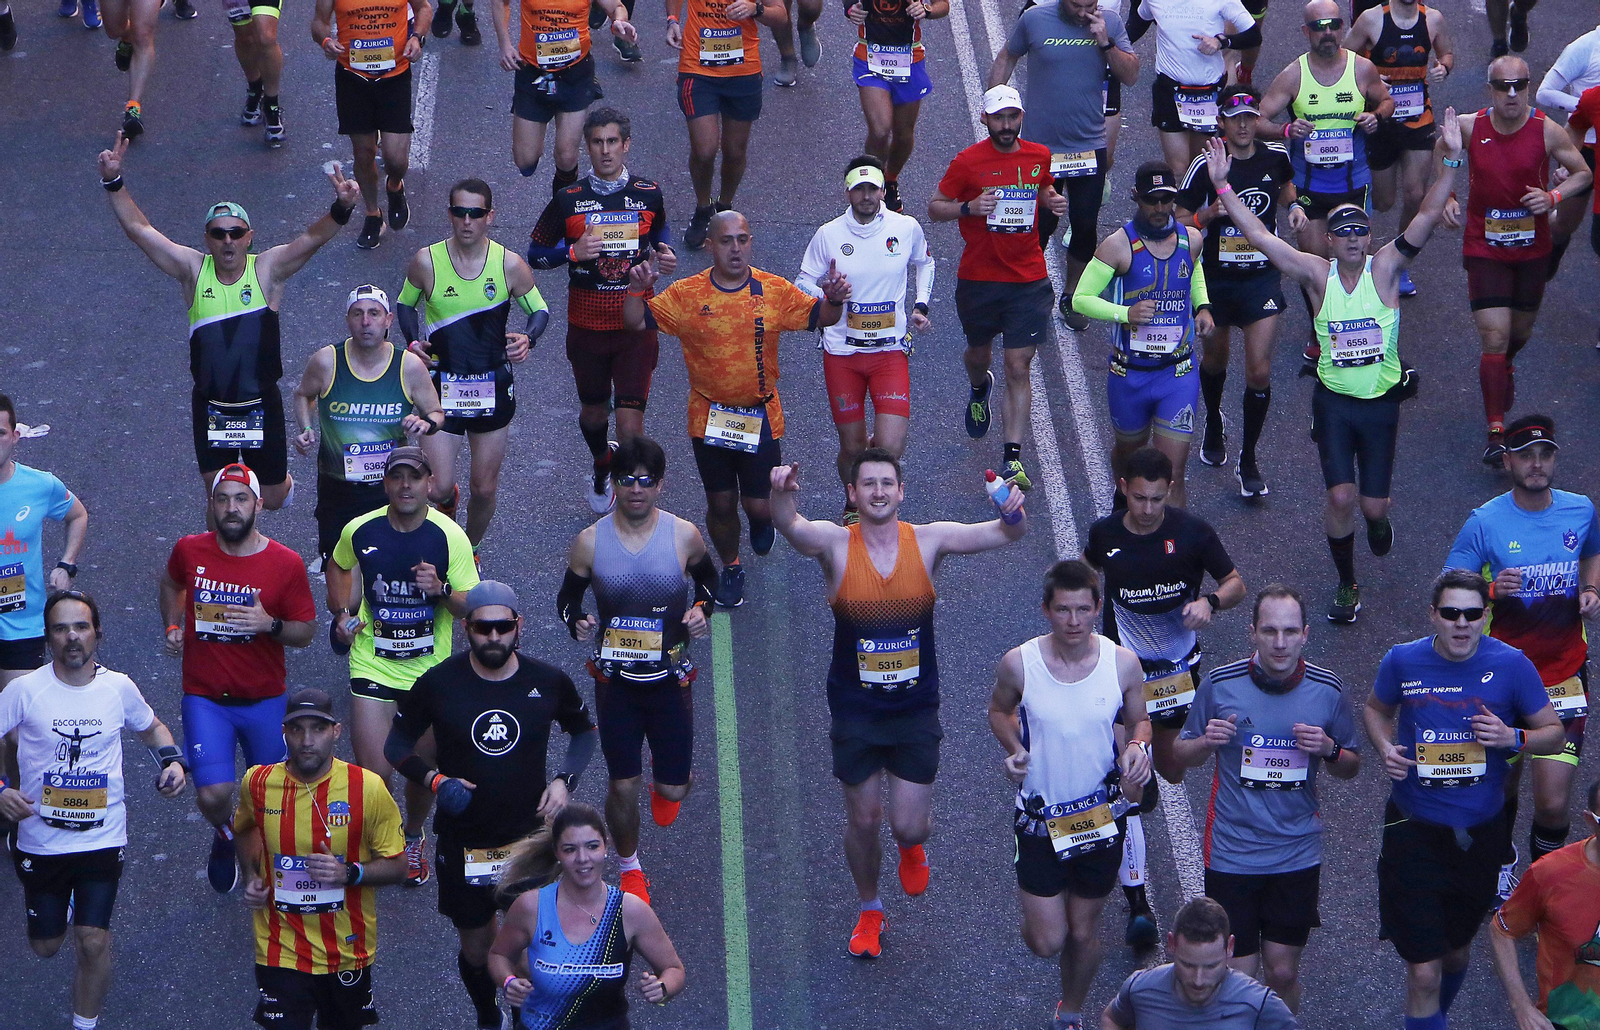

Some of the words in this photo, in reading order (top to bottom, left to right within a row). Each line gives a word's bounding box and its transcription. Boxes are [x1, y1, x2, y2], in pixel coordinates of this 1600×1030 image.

[705, 1, 728, 9] PONT
[539, 16, 569, 24] PONTO
[697, 11, 728, 20] ENCON
[349, 22, 397, 31] ENCONTRO
[548, 31, 575, 42] ZURICH
[712, 29, 738, 38] ZURICH
[362, 39, 389, 48] ZURICH
[713, 43, 732, 52] 5215
[550, 46, 569, 55] 4903
[881, 45, 907, 53] ZURICH
[363, 54, 382, 62] 5058
[548, 54, 572, 63] PACHECO
[880, 59, 898, 67] 6703
[1394, 85, 1419, 94] ZURICH
[1187, 94, 1213, 103] ZURICH
[1188, 108, 1206, 116] 7193
[1394, 109, 1410, 117] AITOR
[1319, 131, 1347, 139] ZURICH
[1319, 145, 1339, 154] 6800
[1063, 152, 1082, 161] 4214
[1319, 155, 1339, 163] MICUPI
[1059, 161, 1087, 171] FRAGUELA
[1006, 190, 1033, 199] ZURICH
[1004, 207, 1024, 215] 9328
[603, 214, 633, 223] ZURICH
[1000, 217, 1025, 226] ALBERTO
[603, 231, 624, 240] 5682
[1234, 254, 1255, 262] VICENT
[862, 304, 891, 313] ZURICH
[861, 320, 882, 330] 5699
[1344, 319, 1376, 331] ZURICH
[1146, 334, 1168, 343] 8124
[1346, 337, 1369, 348] 6558
[1146, 344, 1166, 352] DOMIN
[1355, 349, 1360, 358] Y
[1360, 346, 1381, 357] PEDRO
[754, 316, 766, 393] MARCHENA
[458, 372, 489, 383] ZURICH
[458, 389, 480, 399] 7413
[456, 400, 481, 409] TENORIO
[329, 415, 368, 424] CORREDORES
[225, 421, 247, 430] 2558
[725, 419, 747, 431] 5829
[225, 432, 246, 441] PARRA
[721, 429, 745, 442] BALBOA
[363, 443, 392, 453] ZURICH
[363, 462, 386, 471] 6362
[1119, 583, 1155, 600] Dream
[1154, 580, 1187, 596] Driver
[214, 594, 248, 605] ZURICH
[1127, 596, 1153, 604] COACHING
[1157, 591, 1181, 602] NUTRITION
[652, 606, 668, 614] soar
[213, 612, 226, 622] 41
[391, 610, 427, 620] ZURICH
[621, 619, 655, 630] ZURICH
[391, 629, 416, 639] 1943
[391, 641, 416, 650] SEBAS
[619, 637, 643, 649] 3371
[877, 639, 912, 651] ZURICH
[612, 650, 649, 661] FERNANDO
[877, 660, 903, 671] 5315
[882, 673, 898, 682] LEW
[1153, 684, 1177, 698] 4243
[1432, 686, 1463, 695] MARATHON
[1155, 697, 1178, 711] ARTUR
[52, 718, 103, 727] ESCOLAPIOS
[1438, 732, 1477, 742] ZURICH
[1266, 738, 1297, 748] ZURIC
[1438, 753, 1466, 763] 4385
[1264, 758, 1290, 768] 7693
[1431, 767, 1472, 777] JOHANNES
[65, 778, 101, 788] ZURICH
[62, 797, 89, 808] 5884
[1065, 796, 1099, 814] ZURICH
[52, 809, 96, 820] ALEJANDRO
[1070, 819, 1096, 833] 4536
[1070, 831, 1101, 845] THOMAS
[296, 880, 323, 890] 6951
[301, 894, 317, 903] JON
[534, 959, 560, 974] Fun
[559, 962, 623, 976] Runners
